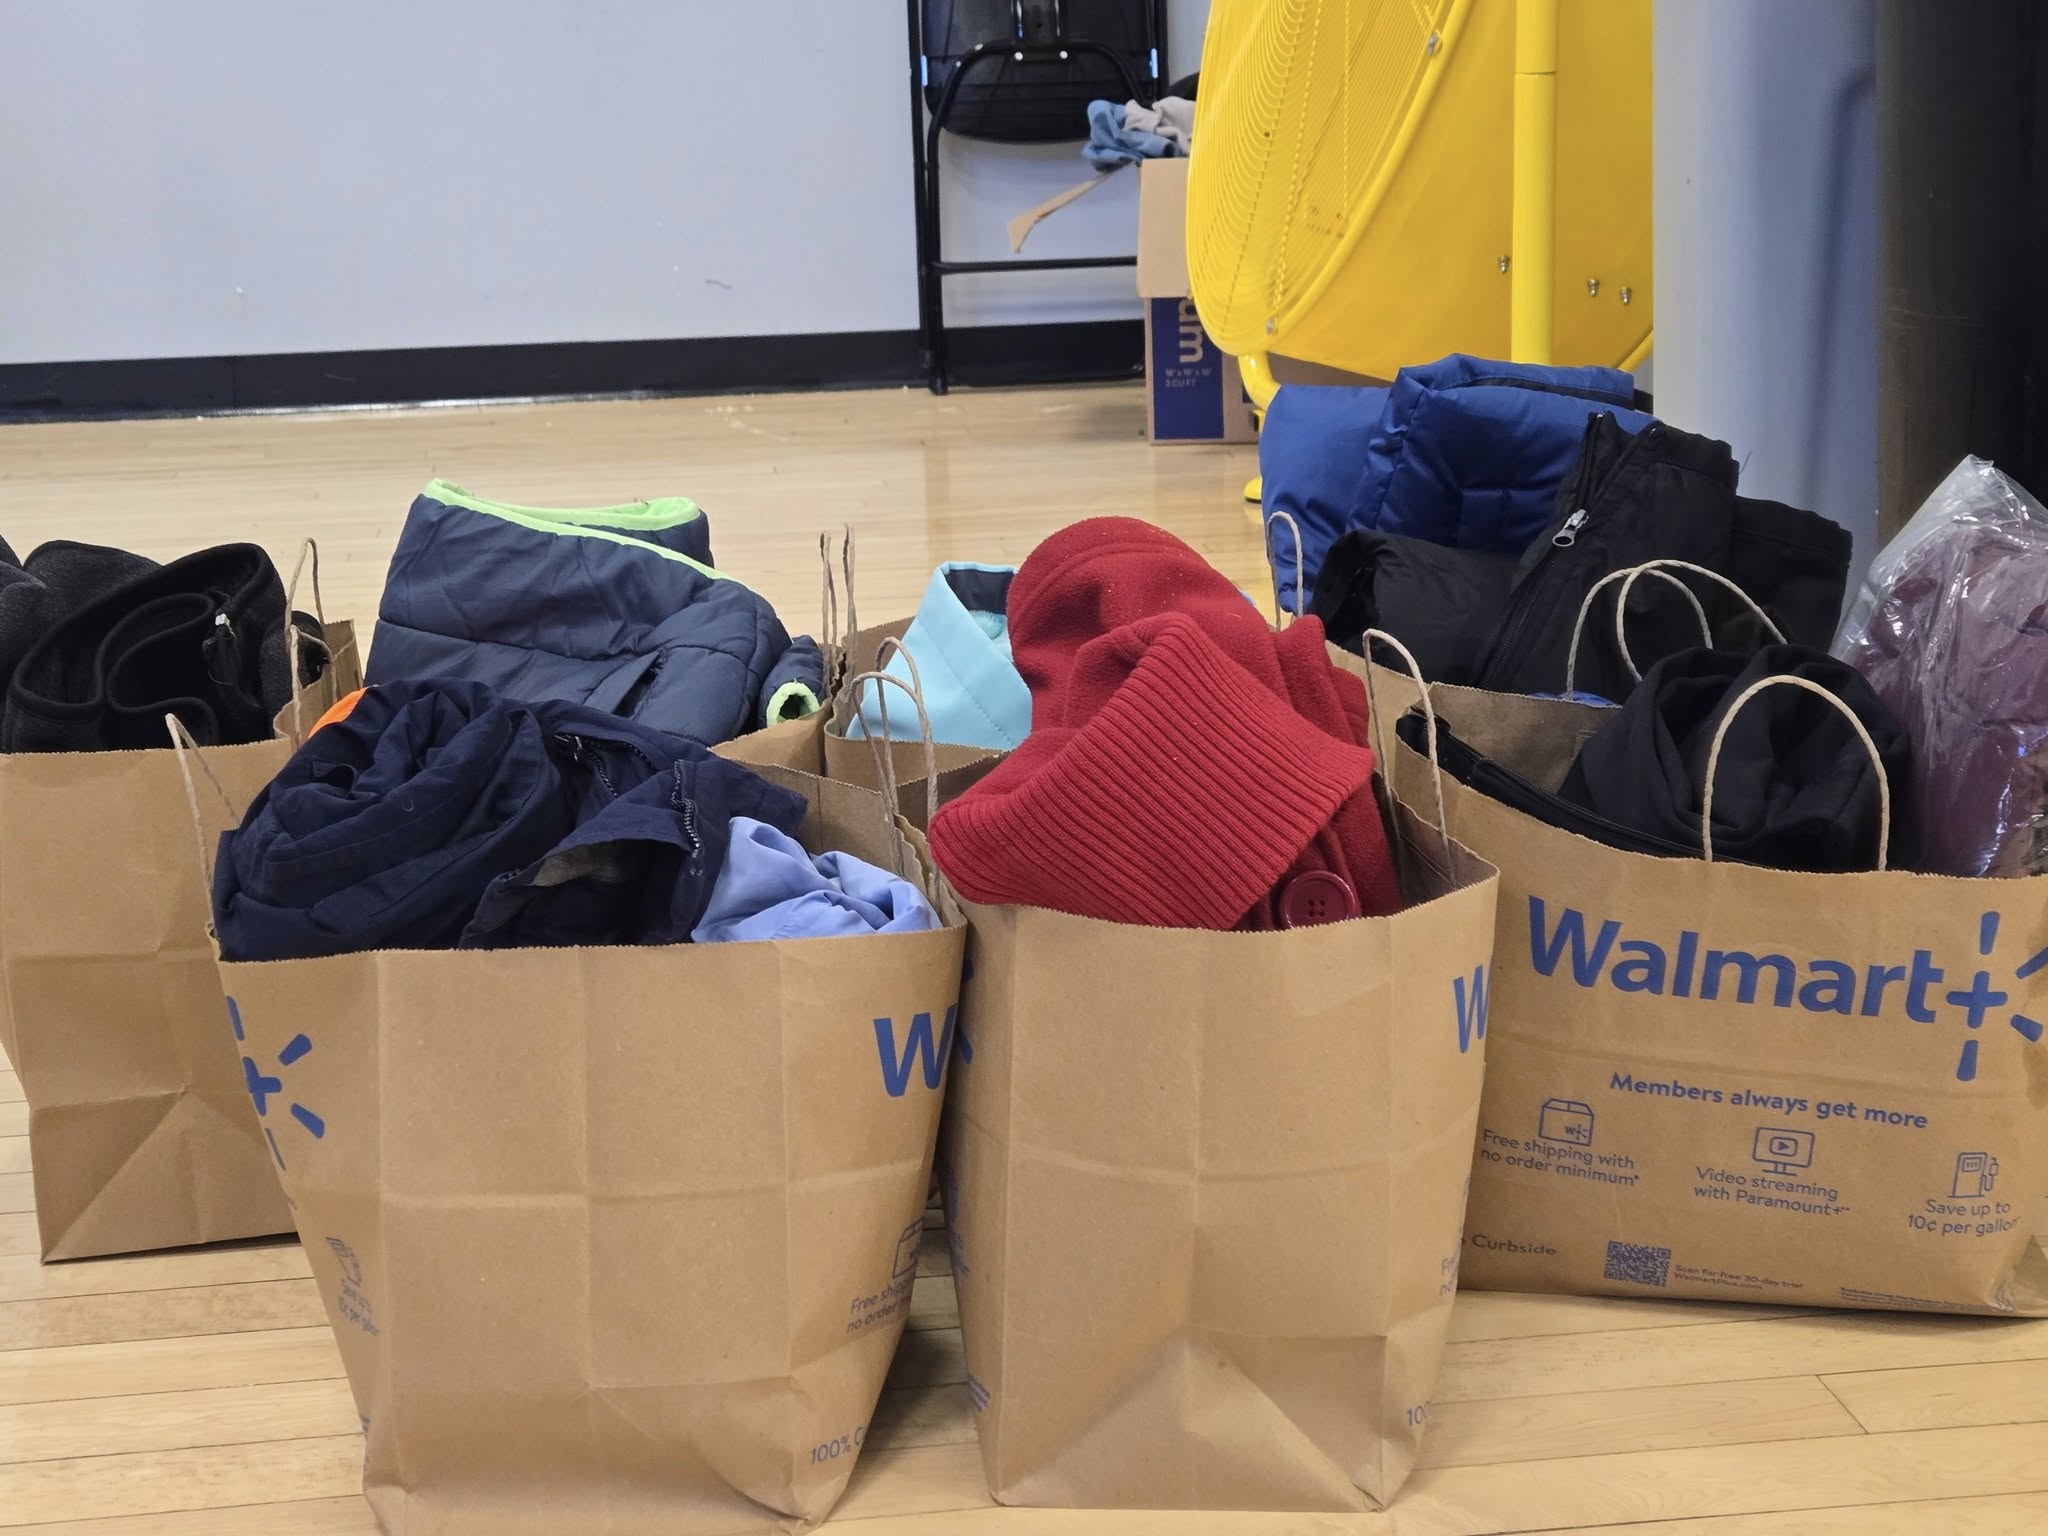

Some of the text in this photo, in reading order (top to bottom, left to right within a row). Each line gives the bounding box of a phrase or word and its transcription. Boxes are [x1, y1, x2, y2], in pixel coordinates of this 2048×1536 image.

[1609, 1072, 1928, 1128] Members always get more
[1481, 1149, 1501, 1162] no
[1505, 1155, 1552, 1171] order
[1482, 1129, 1634, 1169] Free shipping with
[1694, 1185, 1730, 1200] with
[1696, 1165, 1838, 1202] Video streaming
[1926, 1199, 2010, 1219] Save up to
[1908, 1214, 1937, 1232] 10¢
[1942, 1223, 1973, 1237] per
[1471, 1234, 1557, 1255] Curbside
[851, 1294, 878, 1314] Free
[847, 1319, 863, 1335] no
[811, 1434, 852, 1465] 100%
